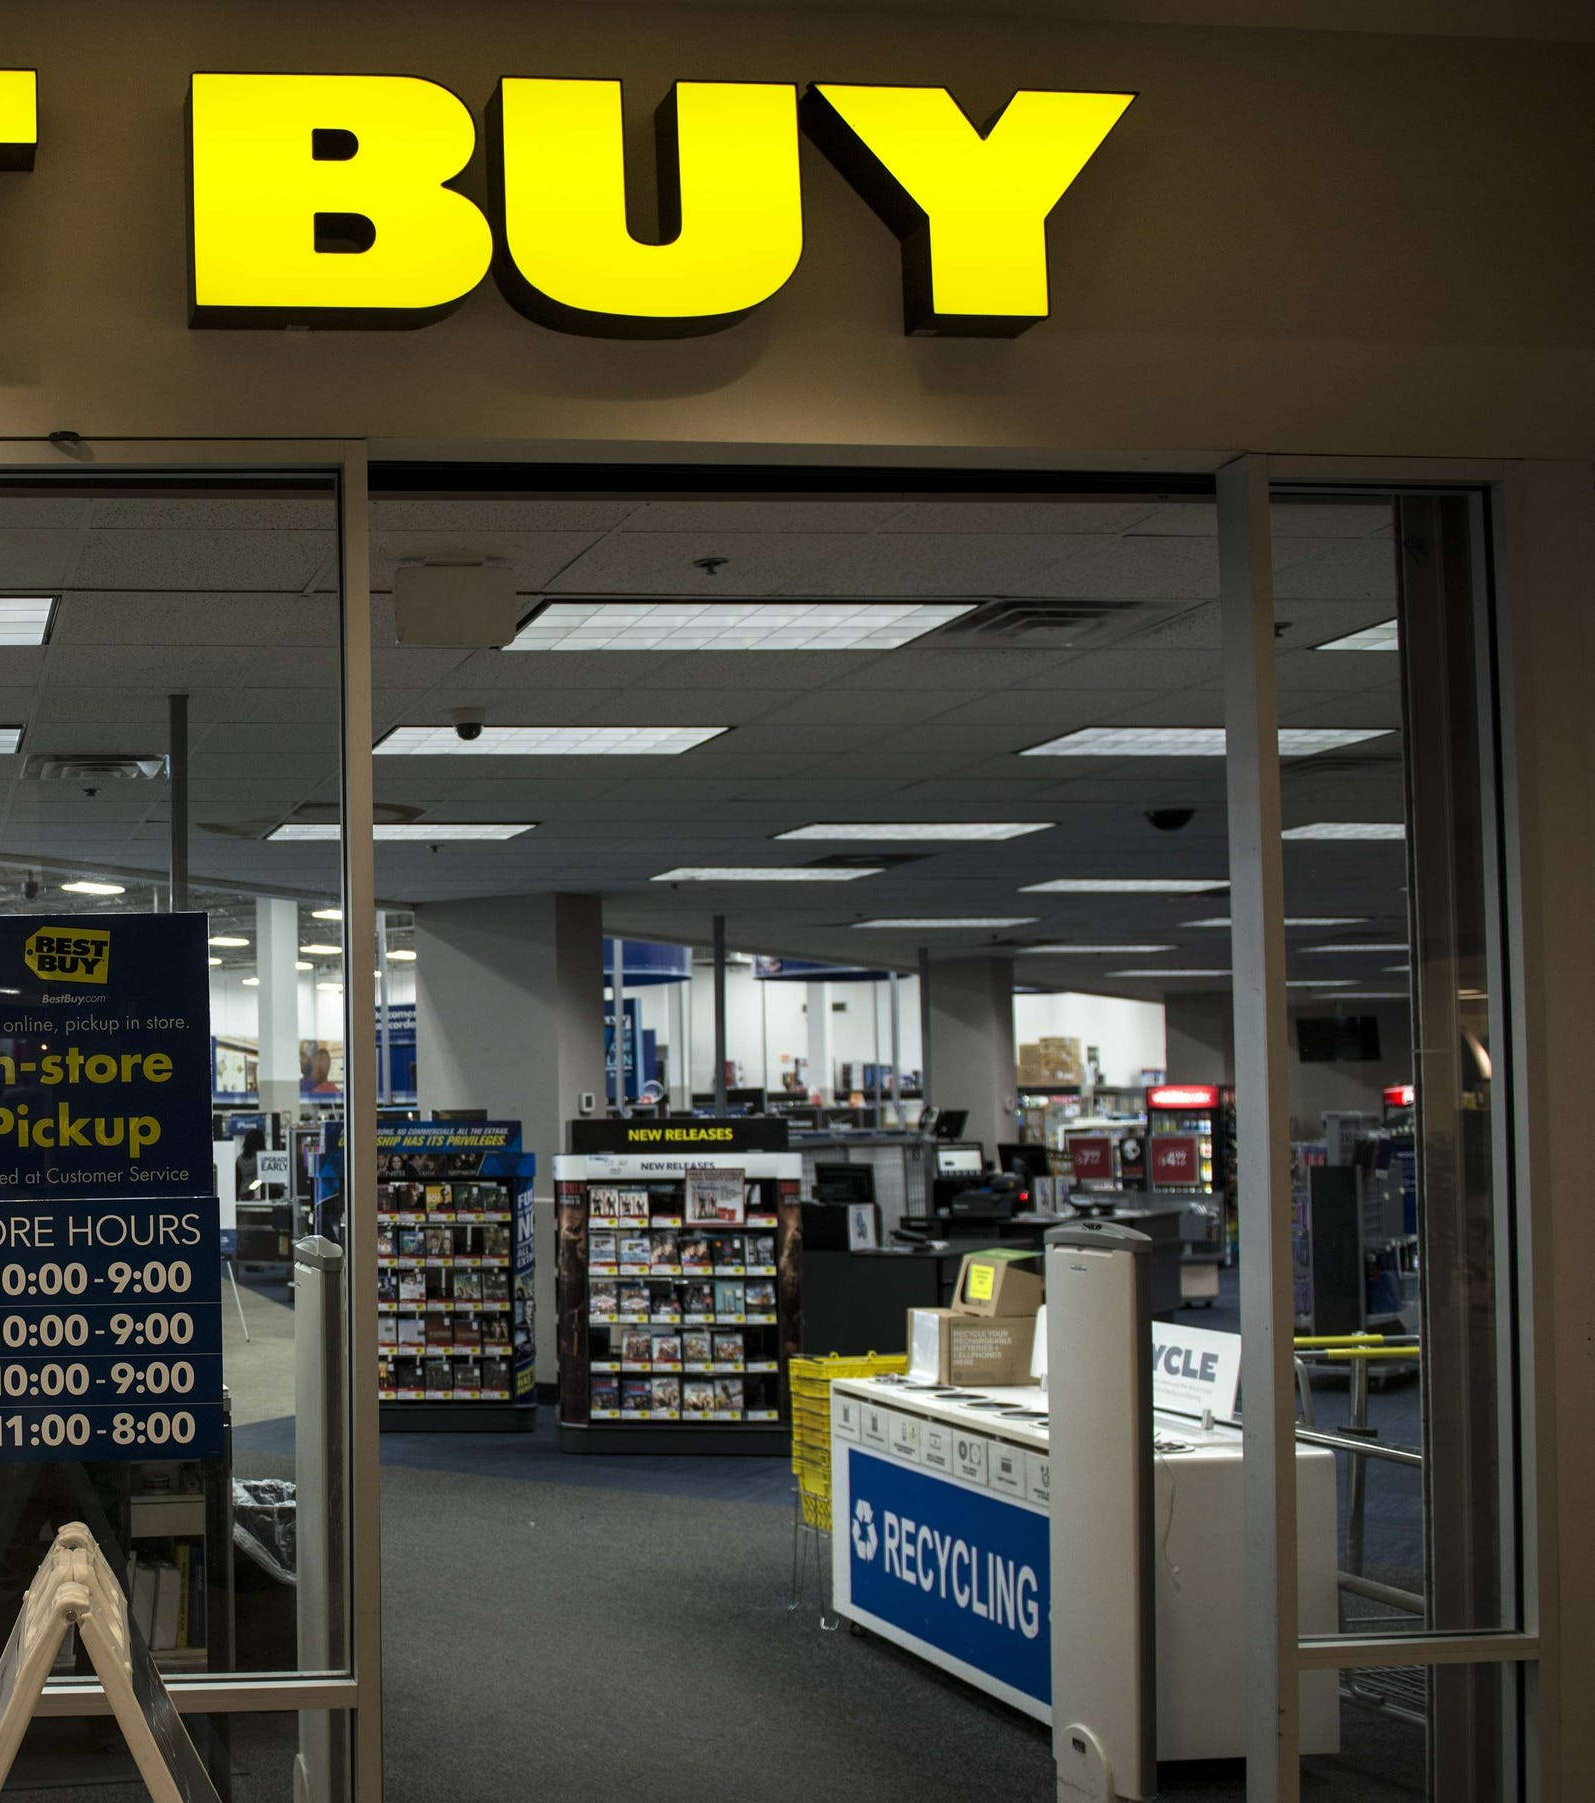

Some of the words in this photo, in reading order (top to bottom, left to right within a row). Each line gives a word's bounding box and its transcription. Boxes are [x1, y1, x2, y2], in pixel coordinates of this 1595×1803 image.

[188, 72, 1141, 332] BUY
[35, 935, 109, 956] BEST
[37, 956, 105, 975] BUY
[41, 993, 107, 1004] BestBuy.com
[3, 1015, 58, 1035] online,
[65, 1015, 119, 1036] pickup
[125, 1015, 140, 1031] in
[146, 1015, 190, 1030] store.
[403, 1136, 424, 1146] HAS
[426, 1136, 444, 1146] ITS
[446, 1136, 507, 1146] PRIVILEGES.
[628, 1129, 662, 1141] NEW
[665, 1128, 734, 1141] RELEASES
[25, 1169, 41, 1185] at
[46, 1167, 123, 1185] Customer
[129, 1166, 190, 1183] Service
[261, 1162, 289, 1172] EARLY
[641, 1162, 665, 1170] NEW
[666, 1161, 715, 1171] RELEASES
[68, 1213, 202, 1247] HOURS
[884, 1510, 1039, 1639] RECYCLING
